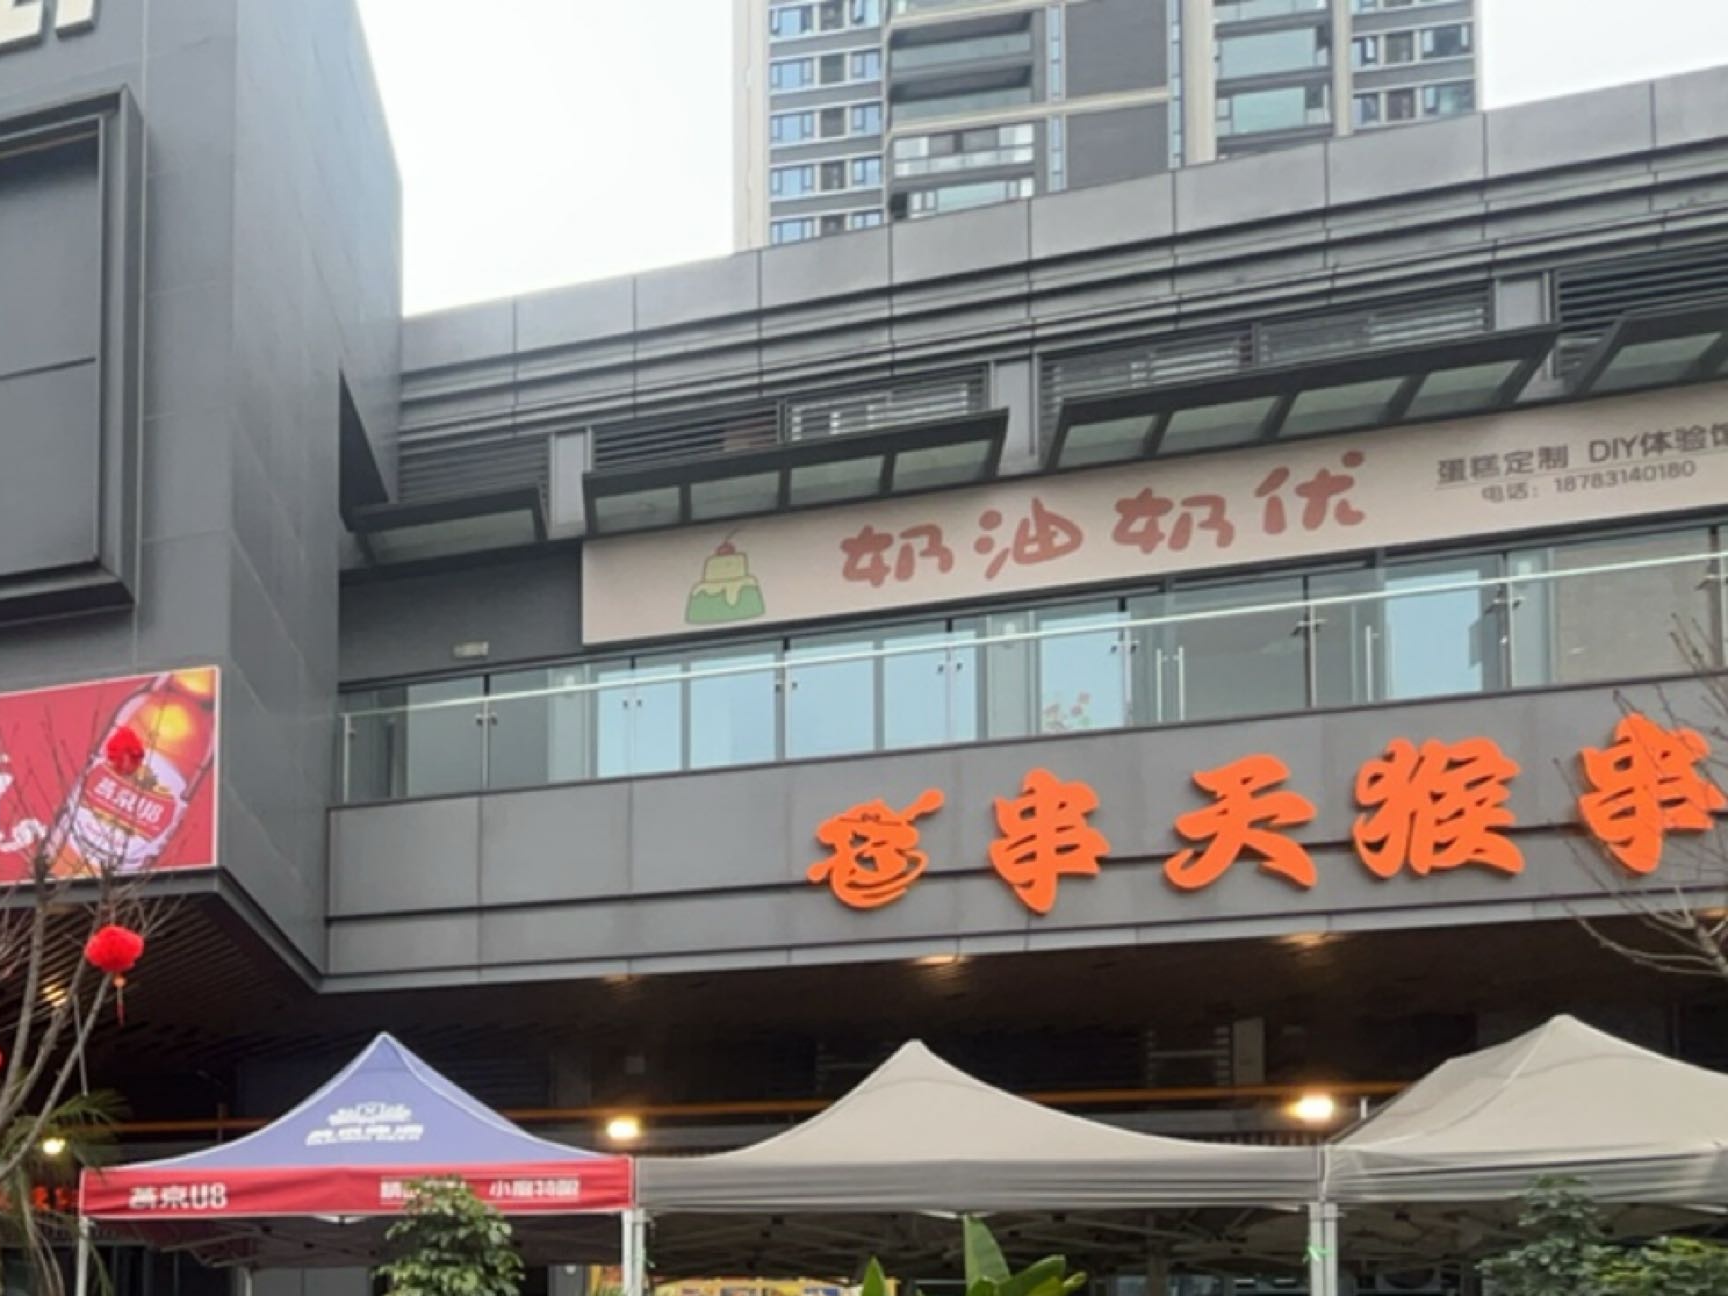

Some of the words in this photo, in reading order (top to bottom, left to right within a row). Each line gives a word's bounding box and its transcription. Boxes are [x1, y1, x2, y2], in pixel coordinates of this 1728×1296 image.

[840, 451, 1367, 588] 奶油奶优
[989, 711, 1728, 915] 串天猴串
